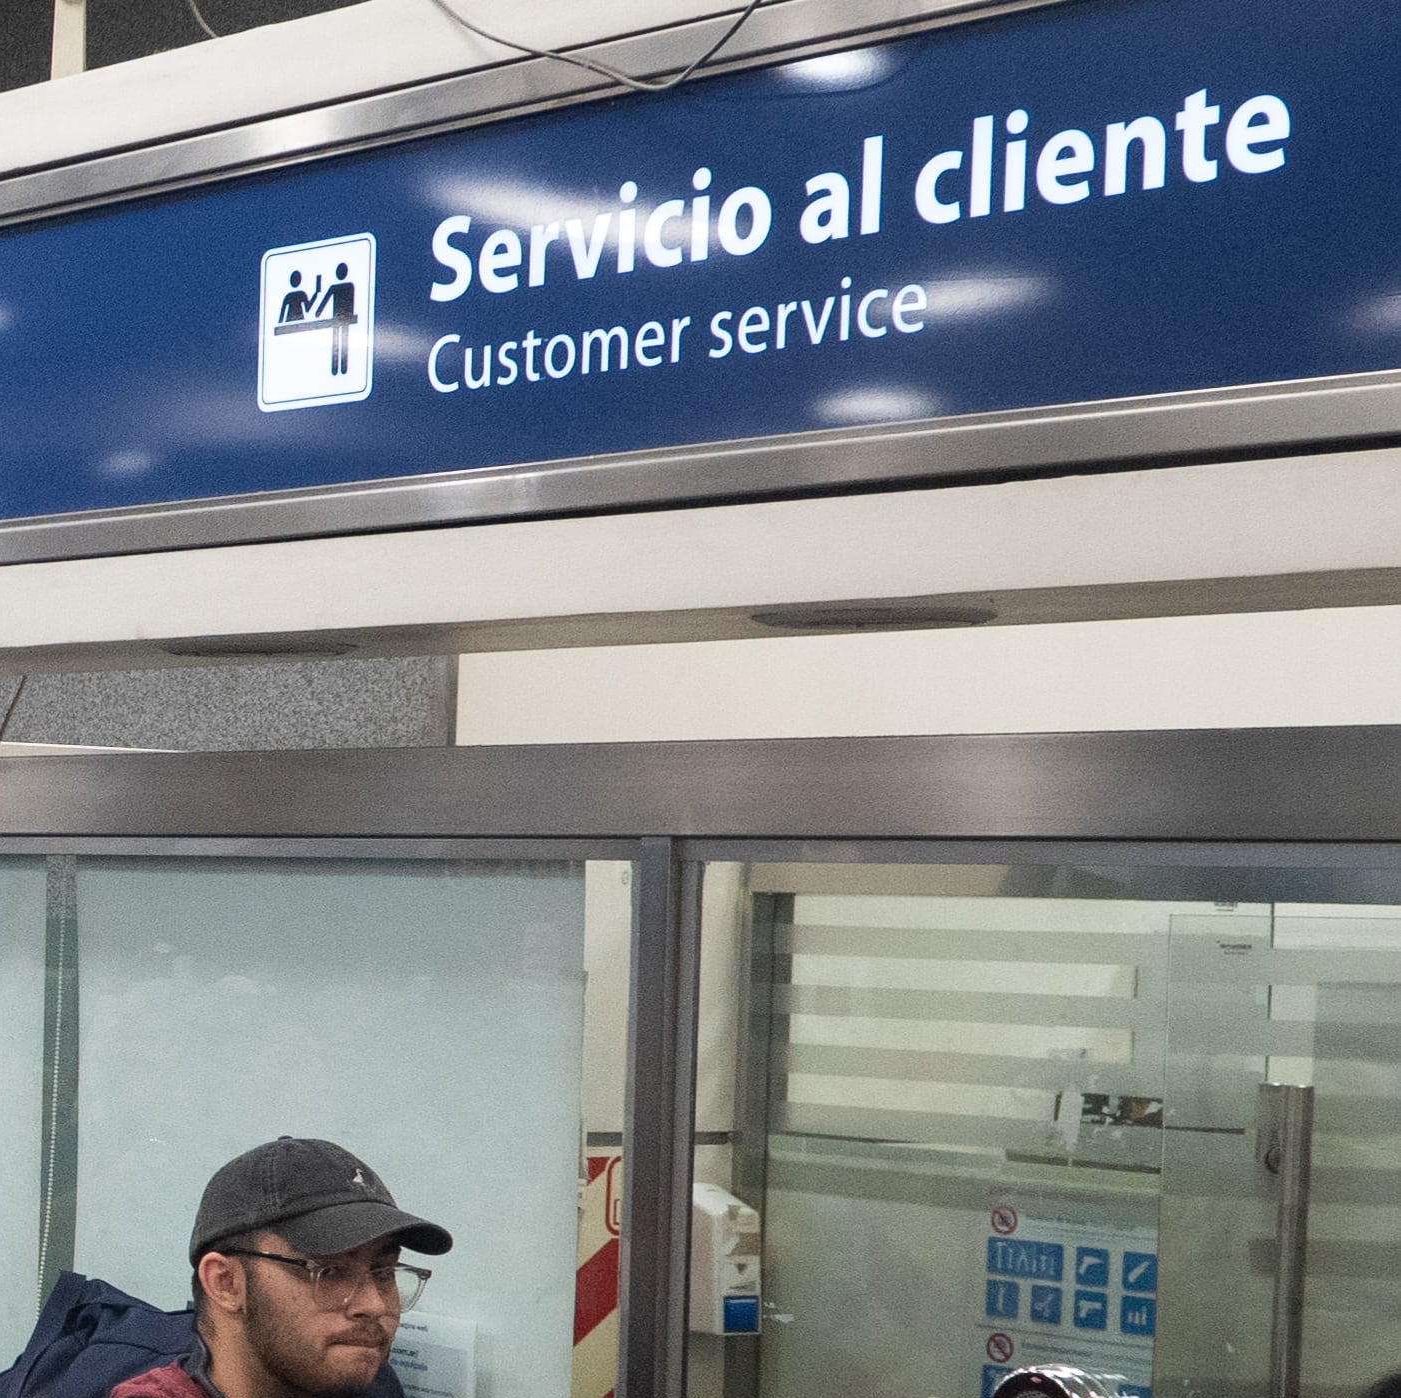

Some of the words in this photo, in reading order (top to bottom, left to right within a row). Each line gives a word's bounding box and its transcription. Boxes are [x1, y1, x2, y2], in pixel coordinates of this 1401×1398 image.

[429, 167, 771, 303] Servicio
[798, 135, 884, 243] al
[914, 87, 1292, 225] cliente
[427, 310, 691, 395] Customer
[708, 276, 929, 361] service
